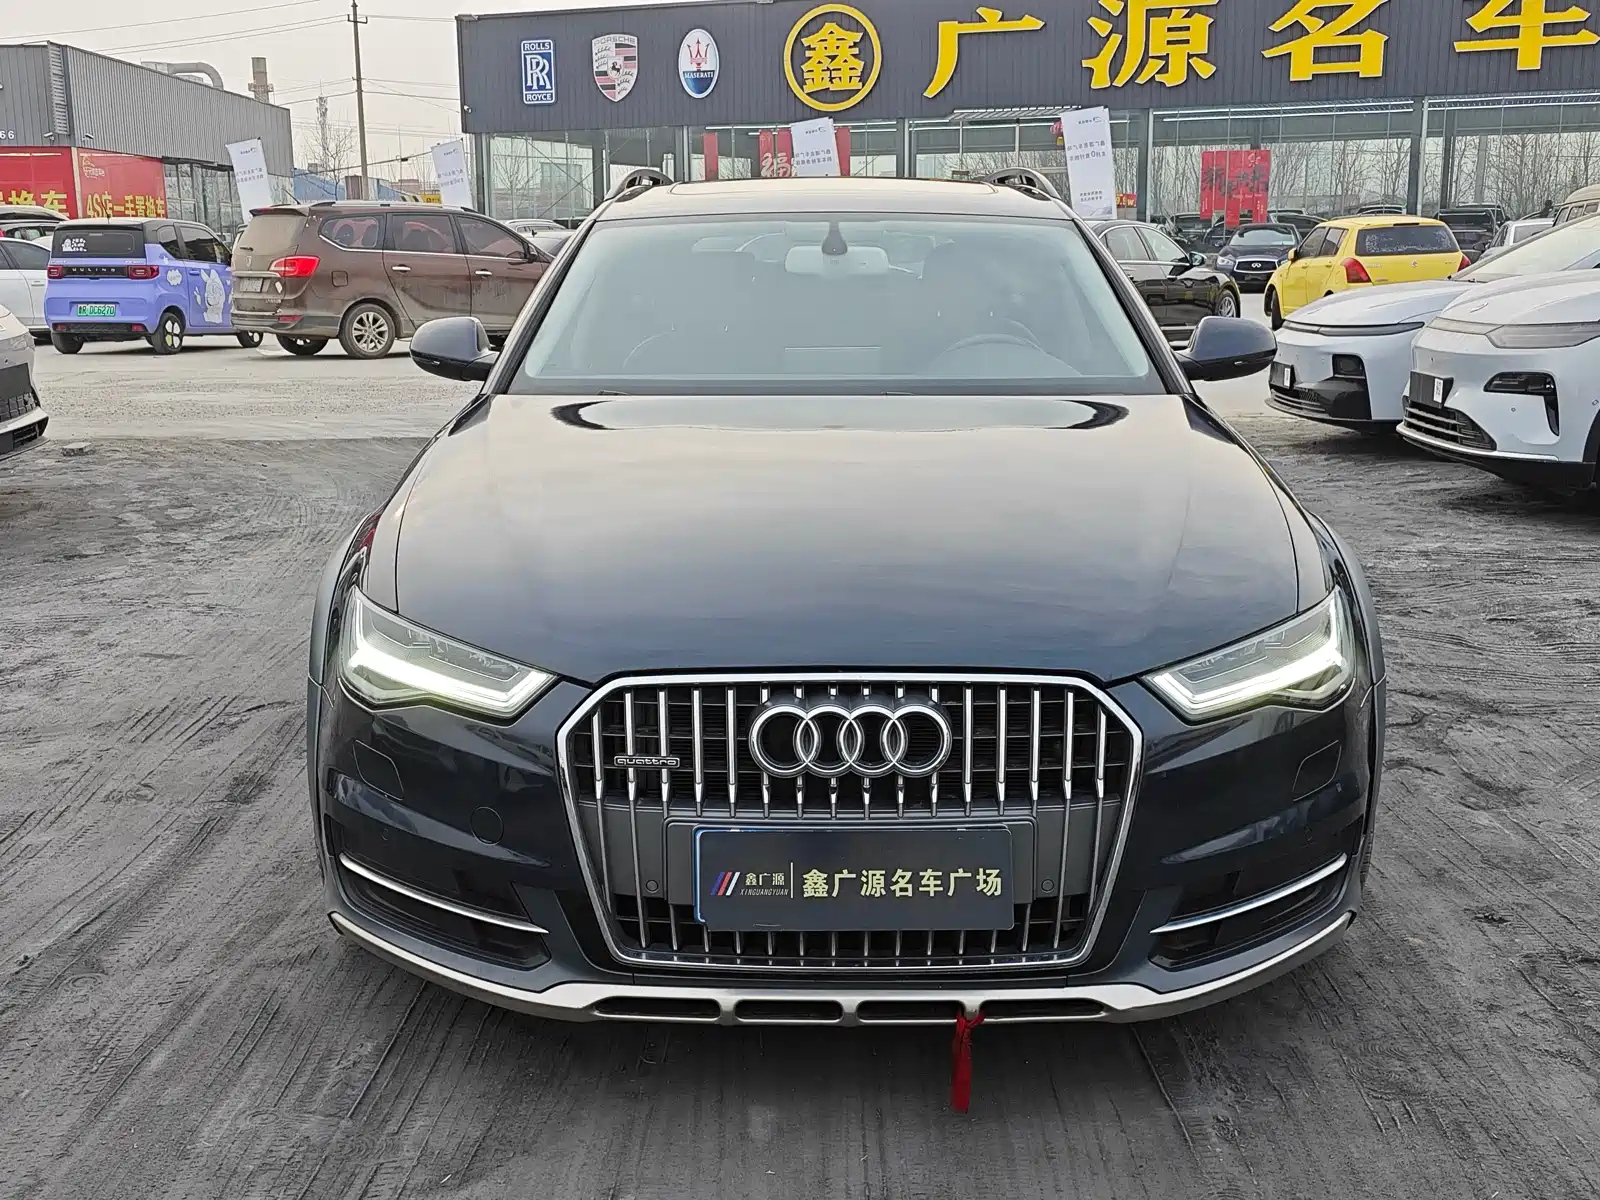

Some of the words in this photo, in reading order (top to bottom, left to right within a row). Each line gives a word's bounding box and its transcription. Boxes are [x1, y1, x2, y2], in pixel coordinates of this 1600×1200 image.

[593, 35, 636, 46] PORSCHE
[524, 42, 550, 51] ROLLS
[683, 71, 714, 79] MASERATI
[526, 92, 552, 101] ROYCE
[617, 758, 677, 766] quattro
[744, 872, 786, 887] 鑫广源
[801, 867, 1003, 899] 鑫广源名车广场
[739, 888, 790, 897] XINGUANGYUAN
